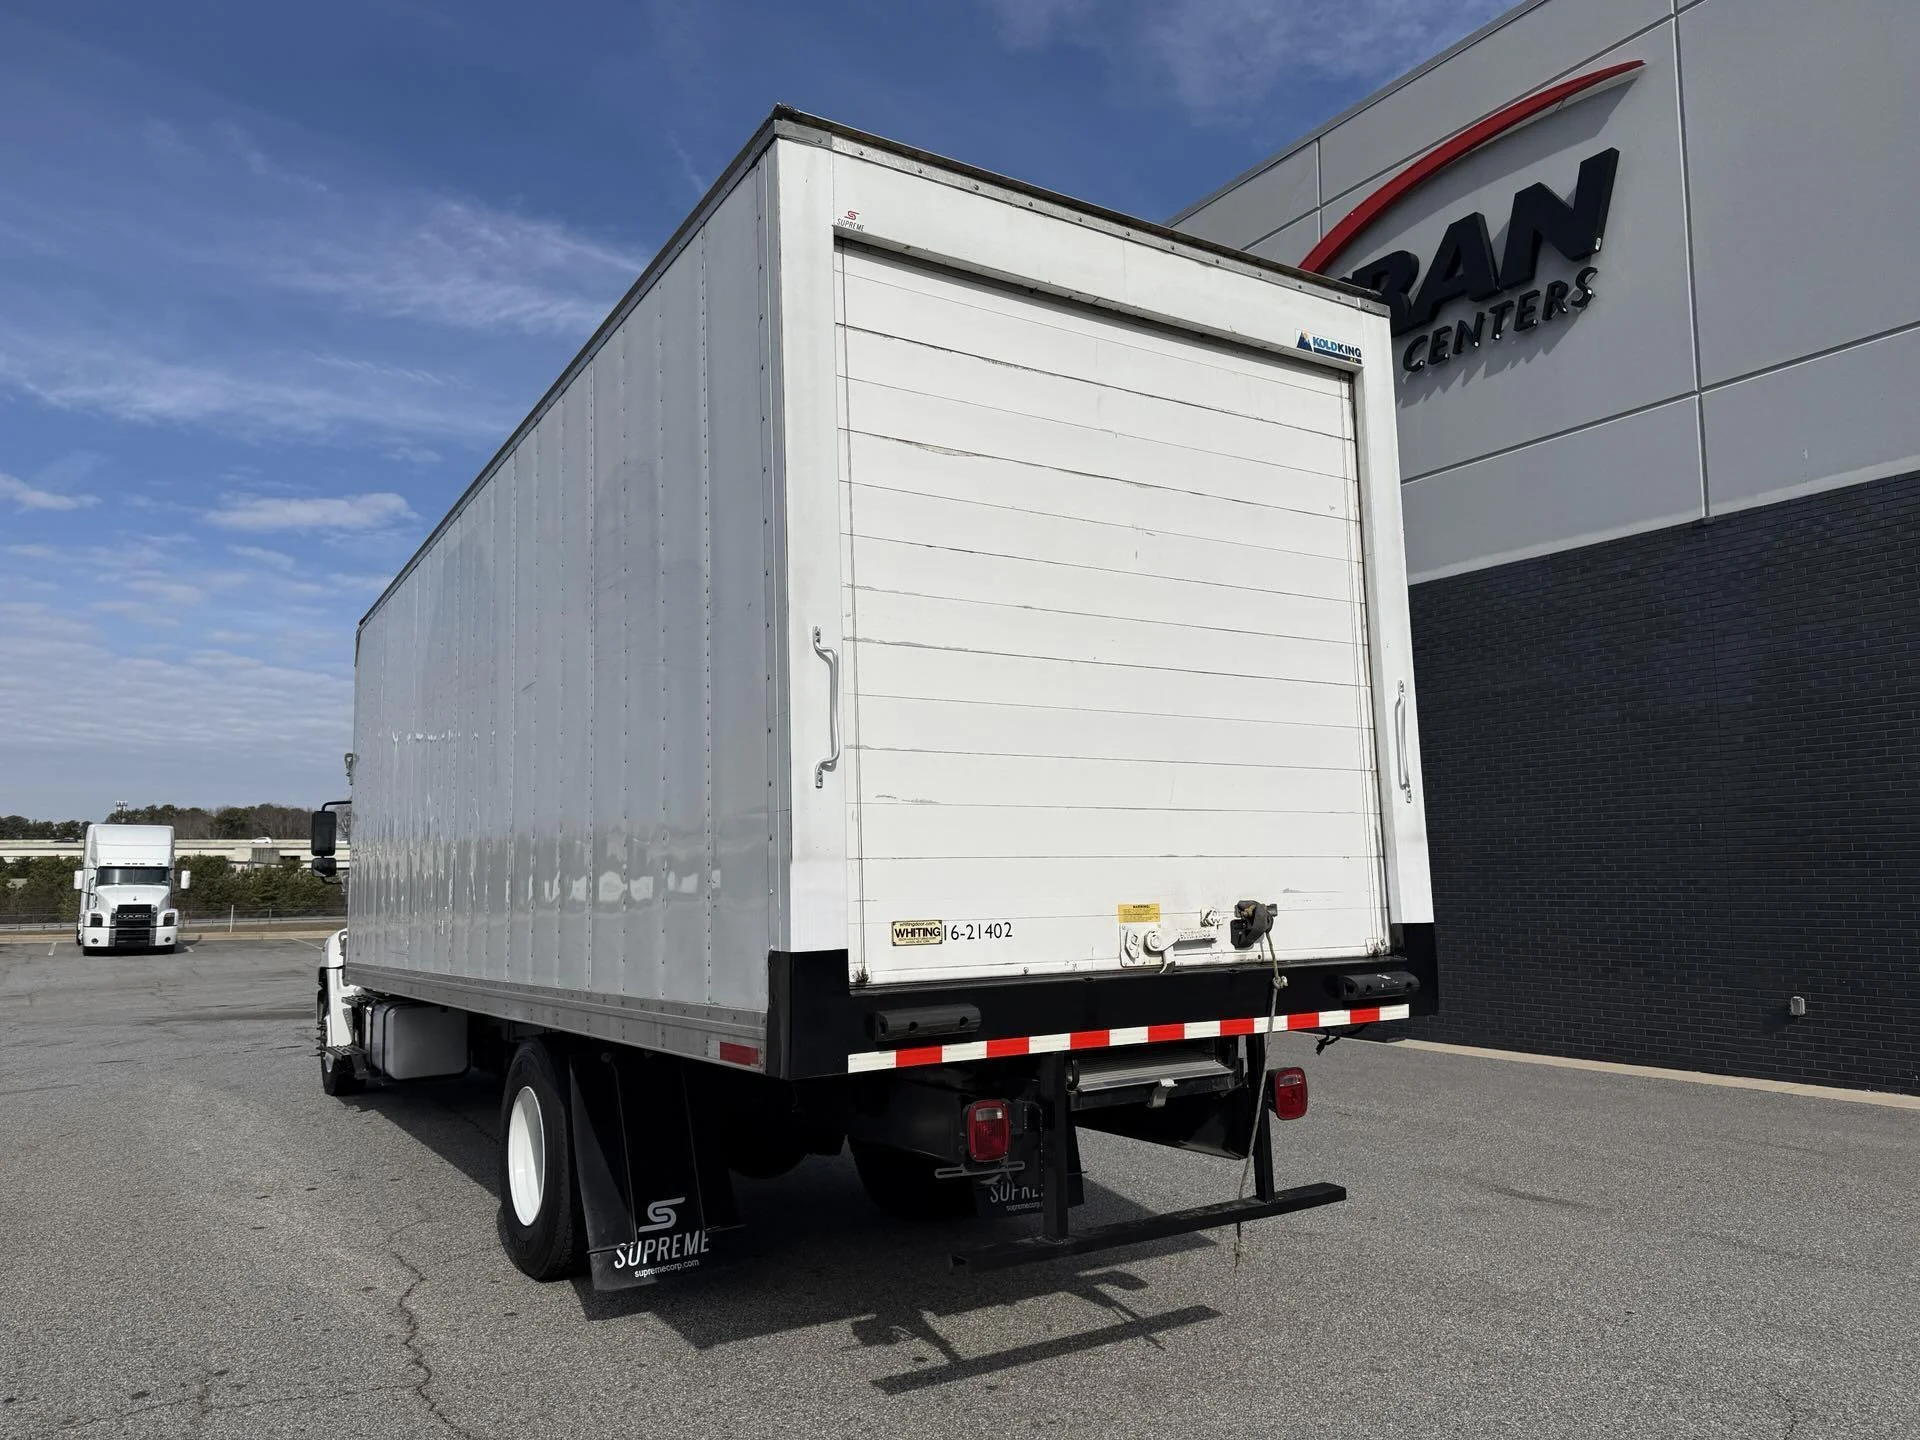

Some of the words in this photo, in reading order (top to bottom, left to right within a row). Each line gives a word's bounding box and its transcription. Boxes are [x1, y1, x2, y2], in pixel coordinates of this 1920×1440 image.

[836, 218, 865, 232] SUPREME
[1339, 147, 1620, 337] RAN
[1403, 266, 1598, 373] CENTERS
[1312, 336, 1362, 358] KOLDKING
[894, 927, 941, 938] WHITING
[944, 922, 1013, 941] 16-21402
[614, 1230, 710, 1269] SUPREME
[634, 1259, 700, 1278] supremecorp.com
